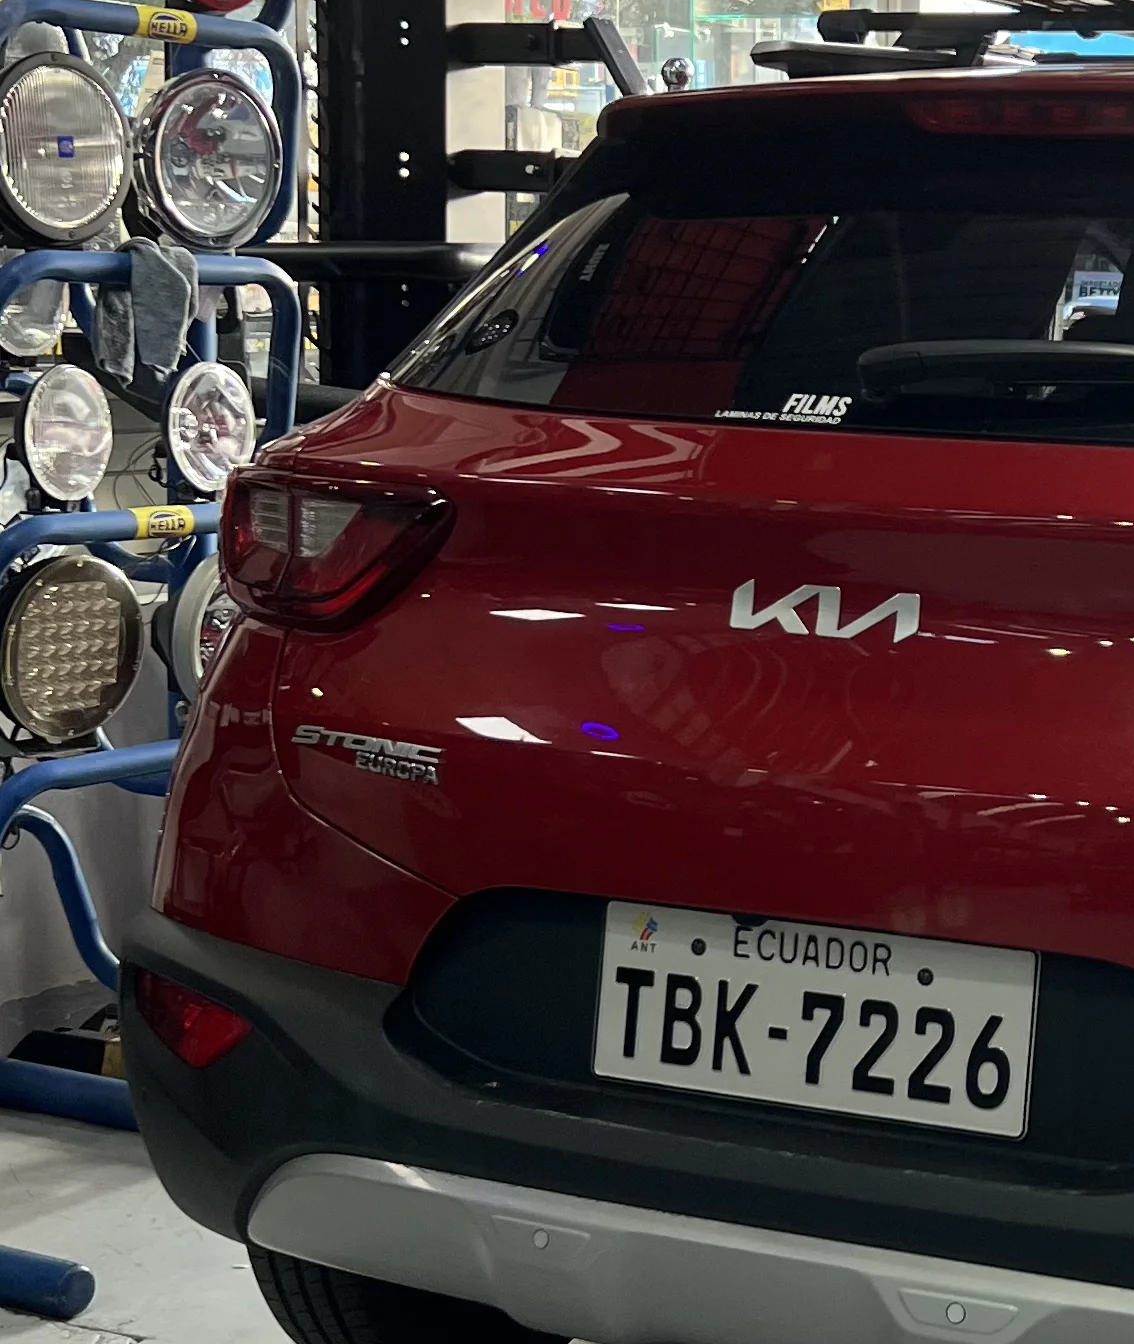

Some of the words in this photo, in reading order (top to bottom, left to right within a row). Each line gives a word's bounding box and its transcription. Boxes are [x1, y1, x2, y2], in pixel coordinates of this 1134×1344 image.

[151, 21, 188, 37] HELLA
[762, 412, 779, 421] DE
[779, 414, 842, 425] SEGURIDAD
[782, 393, 853, 417] FILMS
[150, 517, 186, 531] HELLA
[730, 578, 921, 643] KIA
[290, 724, 447, 764] STONIC
[355, 751, 440, 786] EUROPA
[630, 940, 658, 954] ANT
[732, 924, 893, 976] ECUADOR
[615, 966, 1011, 1110] TBK-7226
